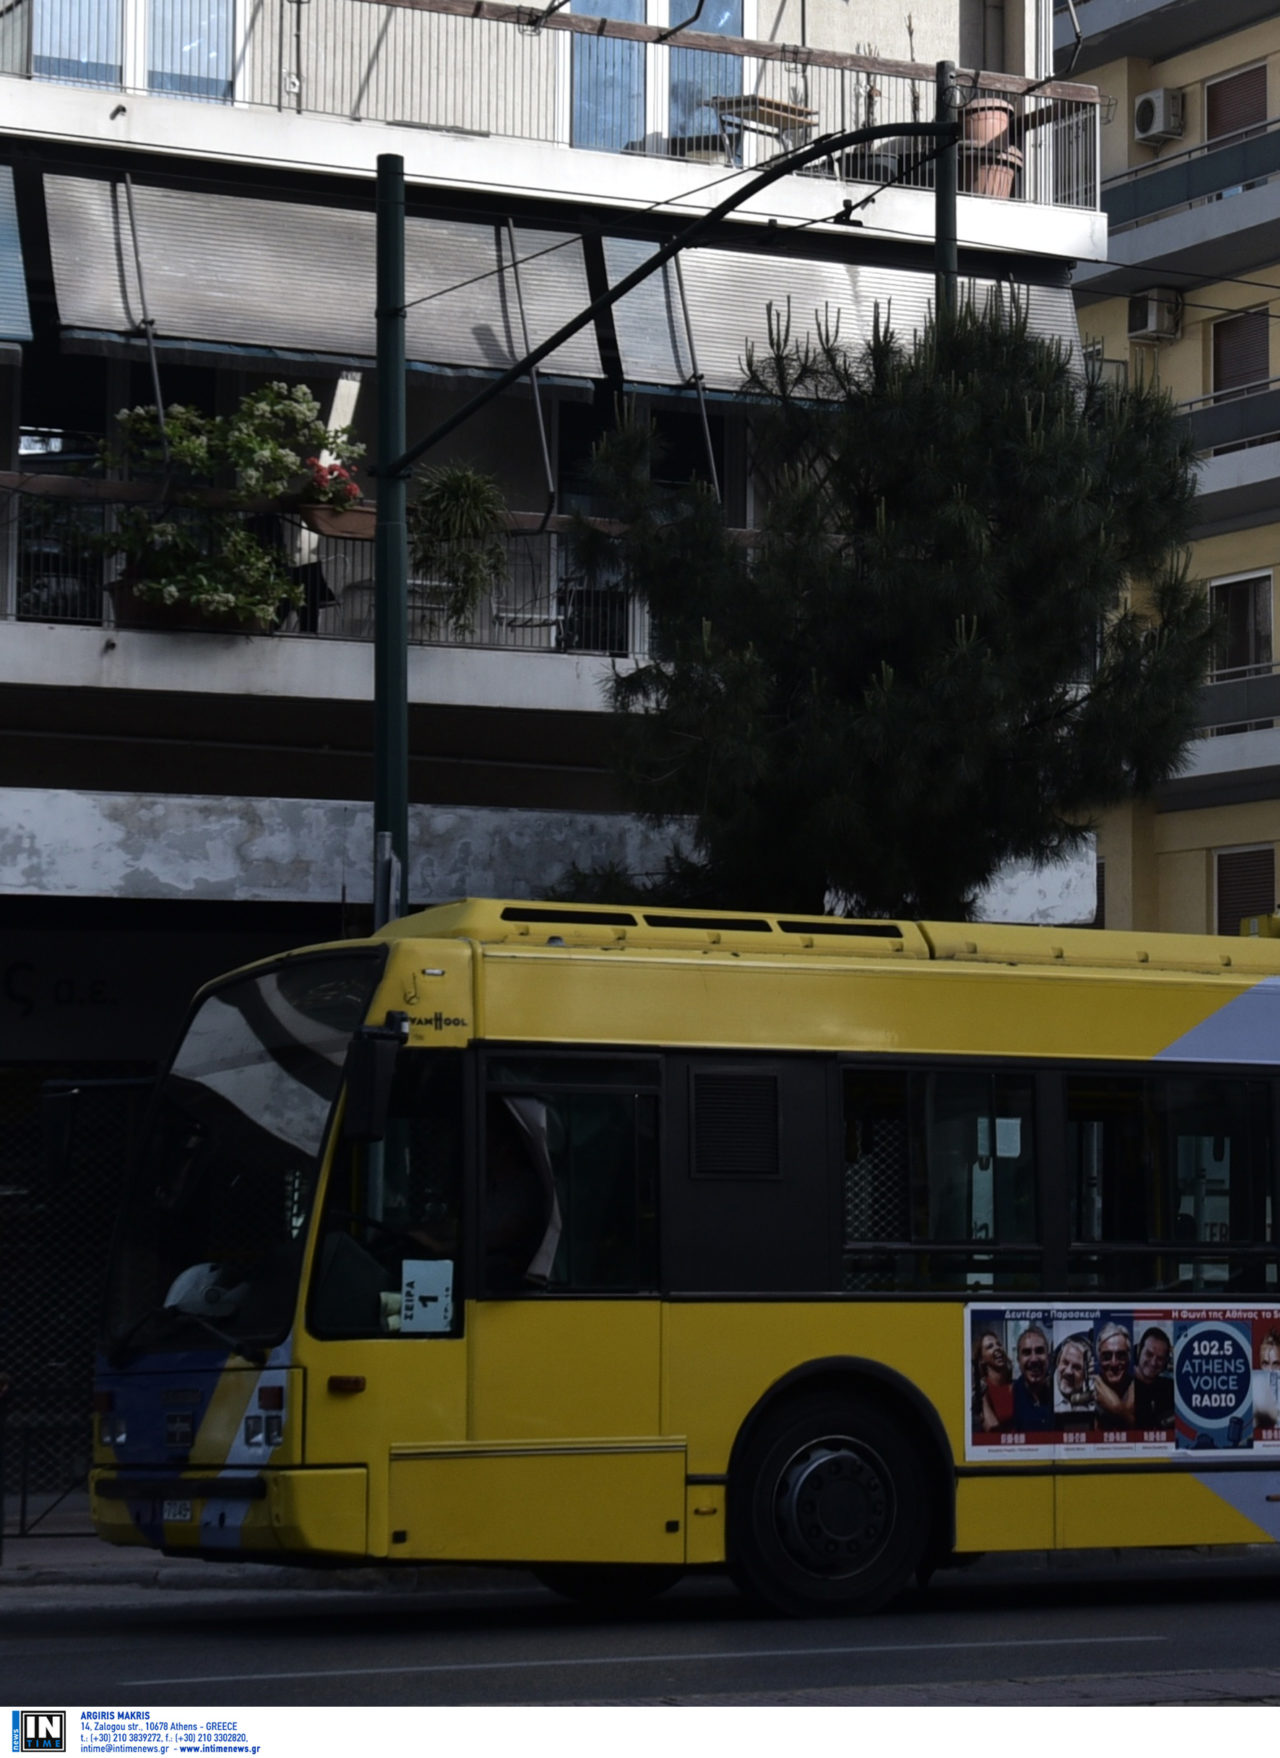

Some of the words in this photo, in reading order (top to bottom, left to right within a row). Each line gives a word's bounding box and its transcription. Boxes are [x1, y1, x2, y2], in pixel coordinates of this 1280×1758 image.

[404, 1281, 415, 1320] ΣΕΙΡΑ
[418, 1296, 438, 1308] 1
[1004, 1310, 1041, 1320] Δευτέρα
[1050, 1310, 1100, 1320] Παρασκευή
[1172, 1310, 1178, 1320] Η
[1180, 1310, 1206, 1320] Φωνή
[1208, 1310, 1223, 1320] της
[1226, 1310, 1259, 1320] Αθήνας
[1261, 1310, 1271, 1320] το
[1192, 1340, 1233, 1356] 102.5
[1182, 1358, 1246, 1374] ATHENS
[1189, 1375, 1239, 1391] VOICE
[1192, 1393, 1236, 1408] RADIO
